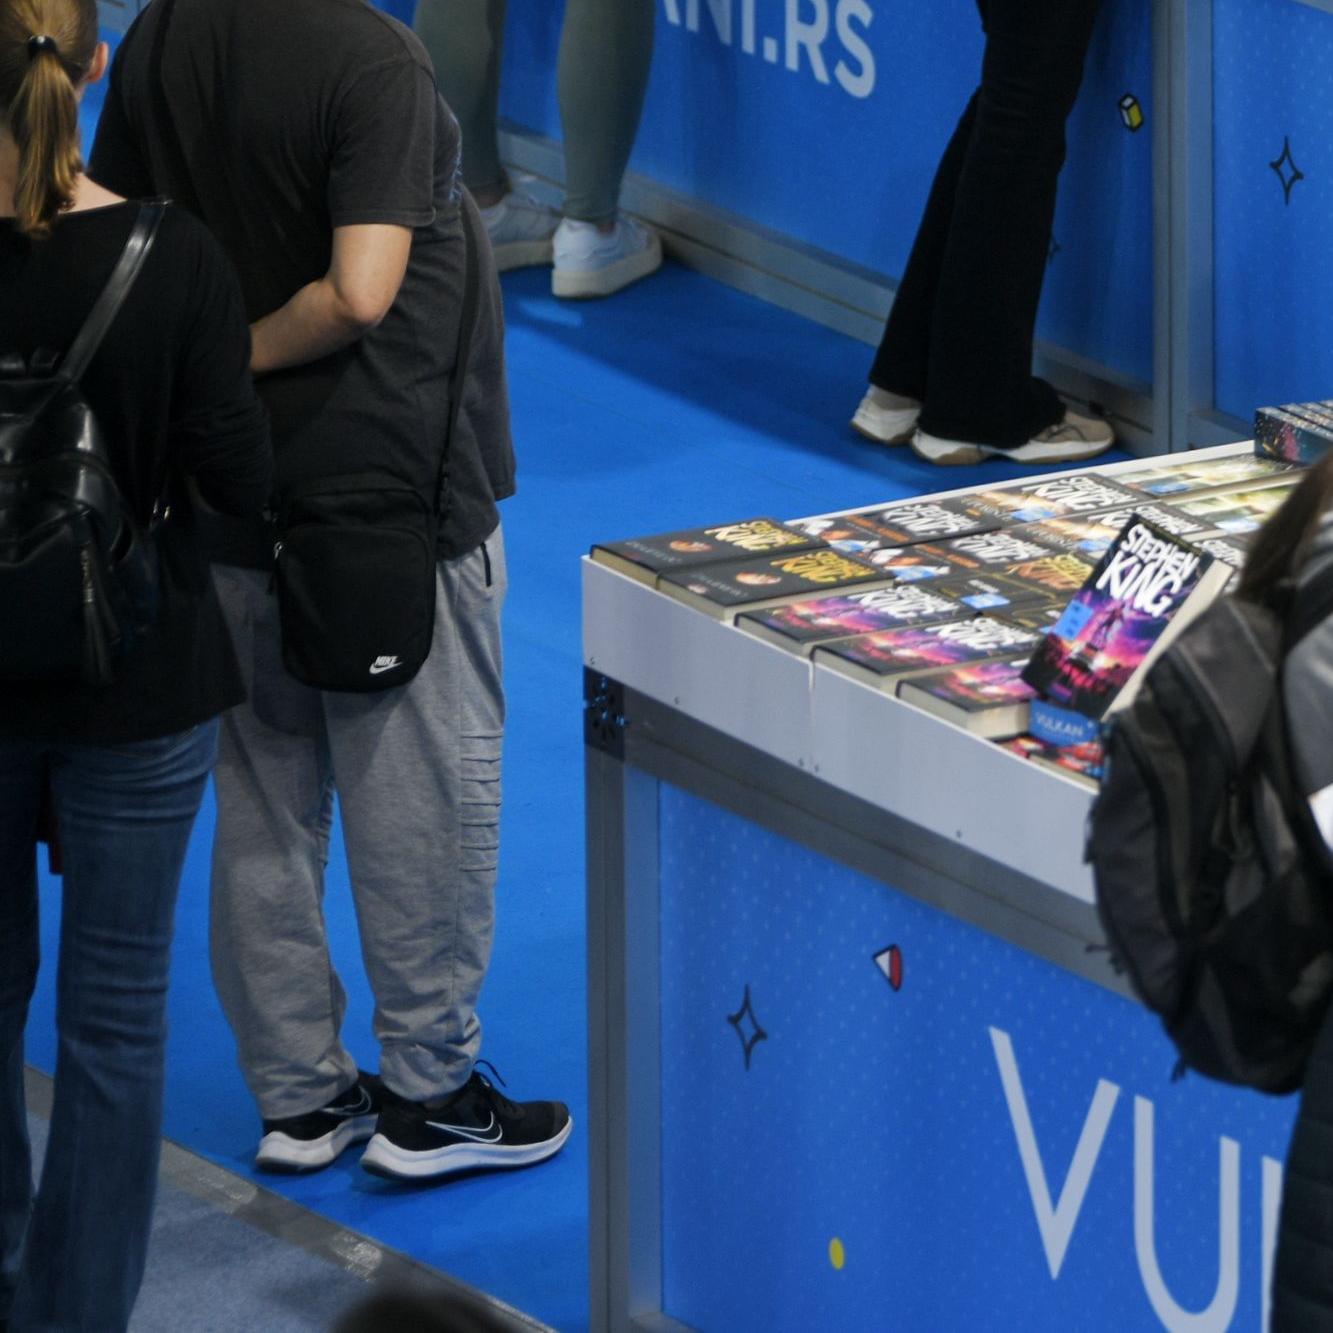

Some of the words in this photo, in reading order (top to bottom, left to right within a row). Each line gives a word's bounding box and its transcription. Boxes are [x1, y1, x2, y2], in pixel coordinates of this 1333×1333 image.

[1022, 480, 1097, 511] KING
[1119, 522, 1200, 581] STEPHEN
[1095, 549, 1183, 619] KING
[375, 655, 398, 666] NIKE
[1034, 710, 1085, 738] VULKAN
